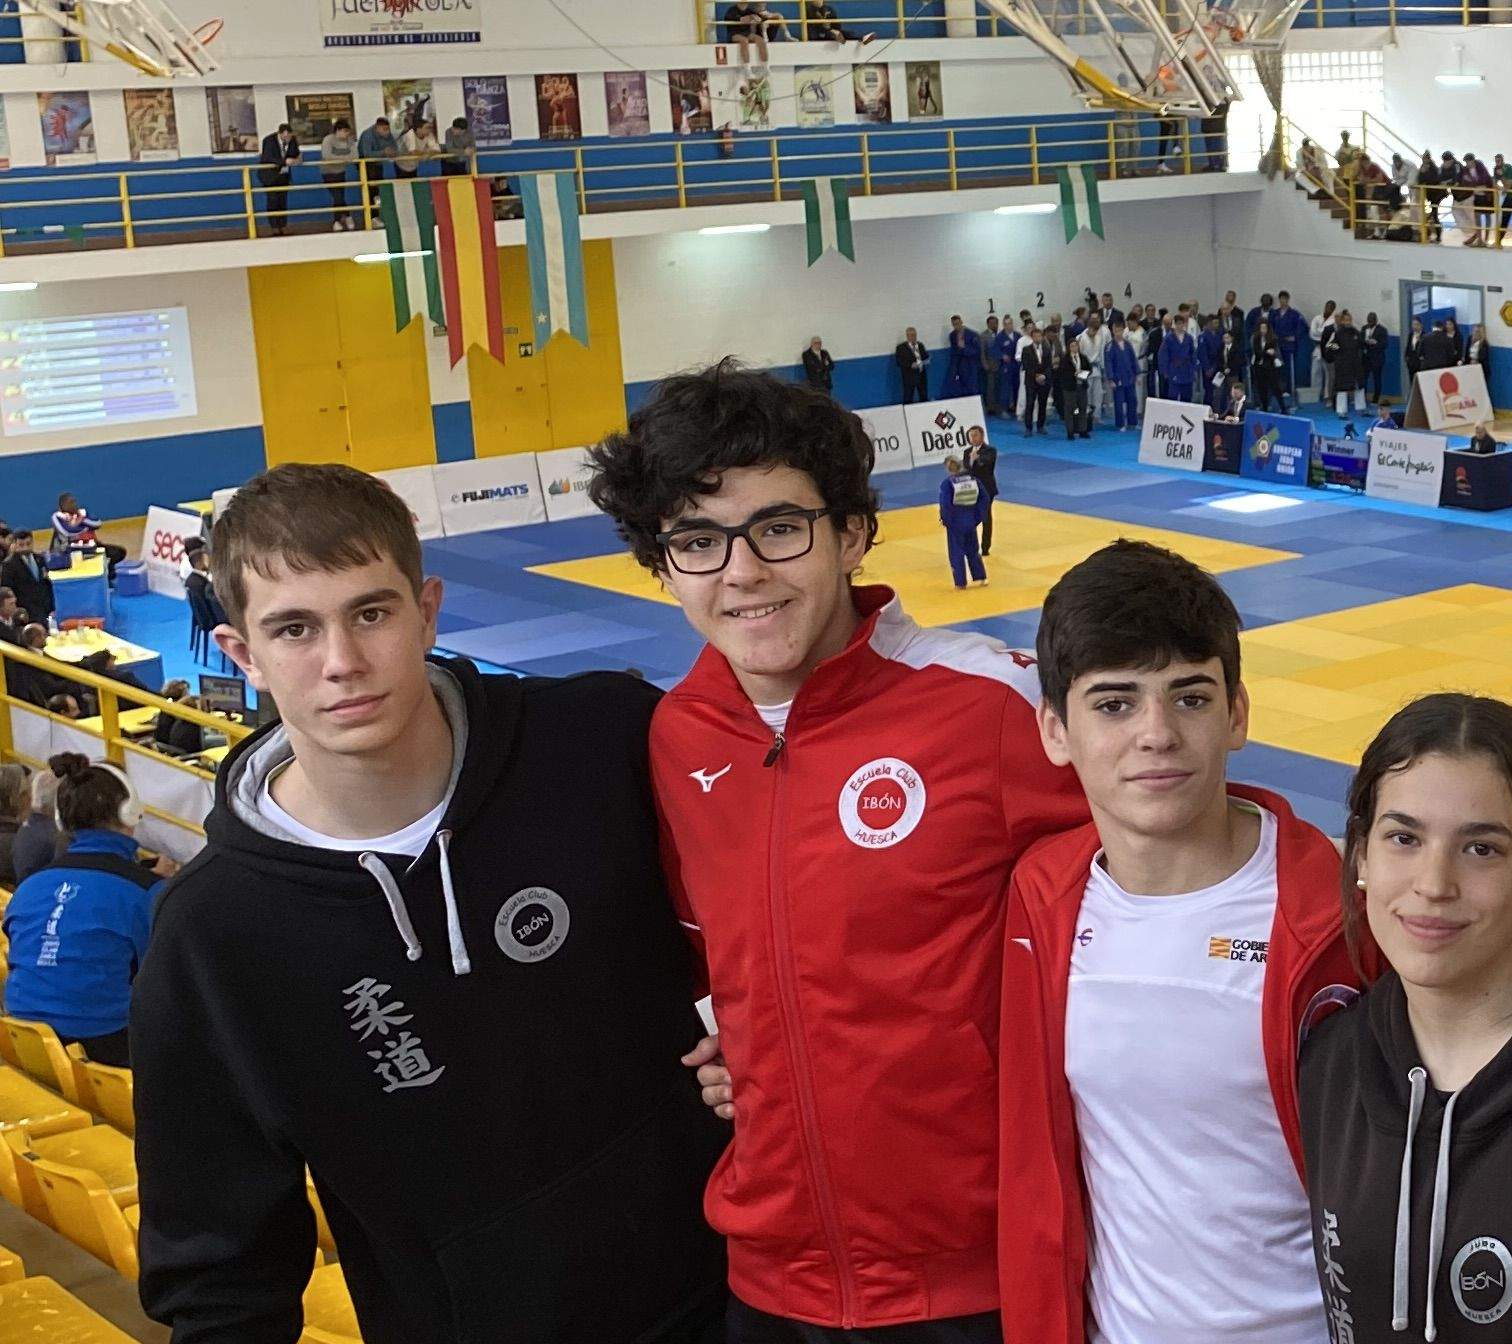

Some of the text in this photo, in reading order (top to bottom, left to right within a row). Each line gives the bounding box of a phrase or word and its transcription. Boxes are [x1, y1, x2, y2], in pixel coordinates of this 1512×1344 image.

[1124, 282, 1133, 299] 4
[987, 297, 996, 314] 1
[1036, 291, 1046, 308] 2
[1152, 423, 1184, 442] IPPON
[1166, 442, 1194, 460] GEAR
[1379, 440, 1408, 452] VIAJES
[462, 483, 529, 503] FUJIMATS
[850, 763, 917, 792] Escuela Club
[861, 792, 901, 810] IBÓN
[855, 828, 898, 845] HUESCA
[516, 912, 550, 940] IBÓN
[1231, 938, 1270, 953] GOBIE
[1230, 950, 1248, 962] DE
[342, 977, 446, 1094] 柔道
